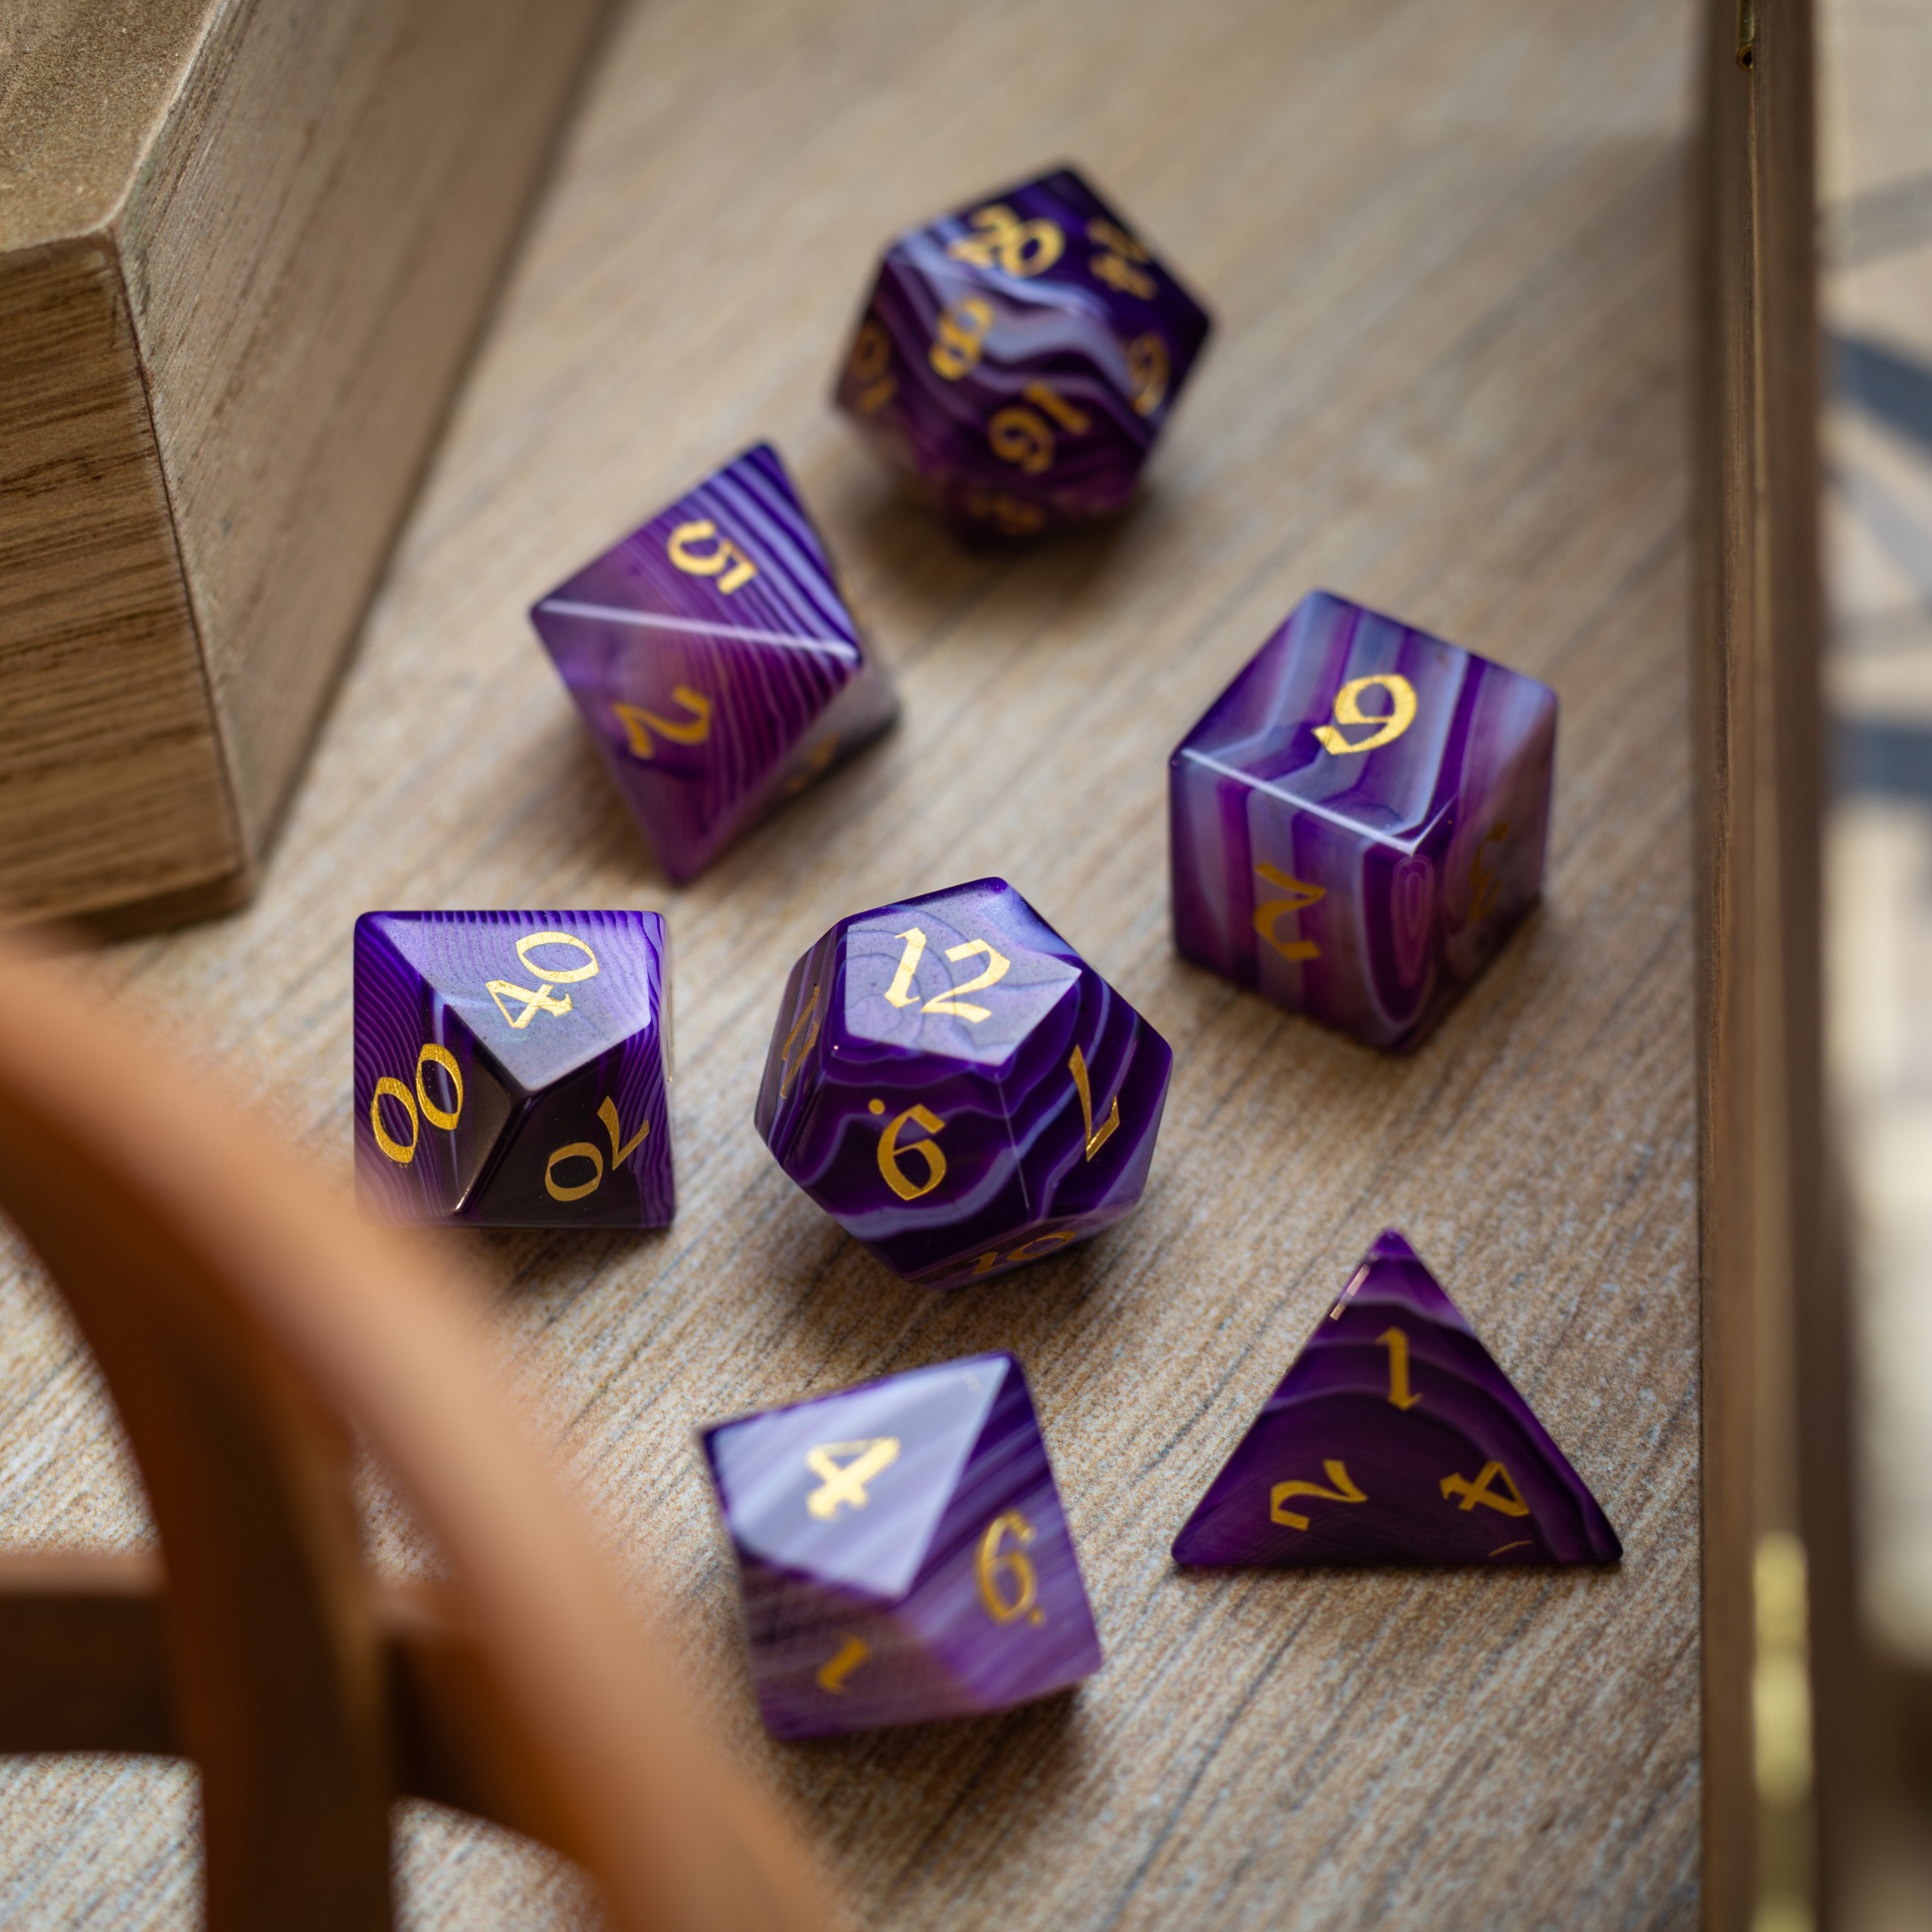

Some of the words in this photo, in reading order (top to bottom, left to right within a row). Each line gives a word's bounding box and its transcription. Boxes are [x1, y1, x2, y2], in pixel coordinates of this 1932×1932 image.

[946, 204, 1065, 277] 20
[929, 299, 993, 380] 8
[667, 519, 758, 595] 5
[612, 682, 712, 760] 2
[1252, 862, 1326, 961] 2
[485, 931, 599, 1029] 40
[884, 927, 1010, 1023] 12
[370, 1043, 464, 1163] 00
[1374, 1327, 1423, 1411] 1
[805, 1436, 900, 1521] 4
[1271, 1458, 1368, 1531] 2
[1440, 1460, 1529, 1517] 4
